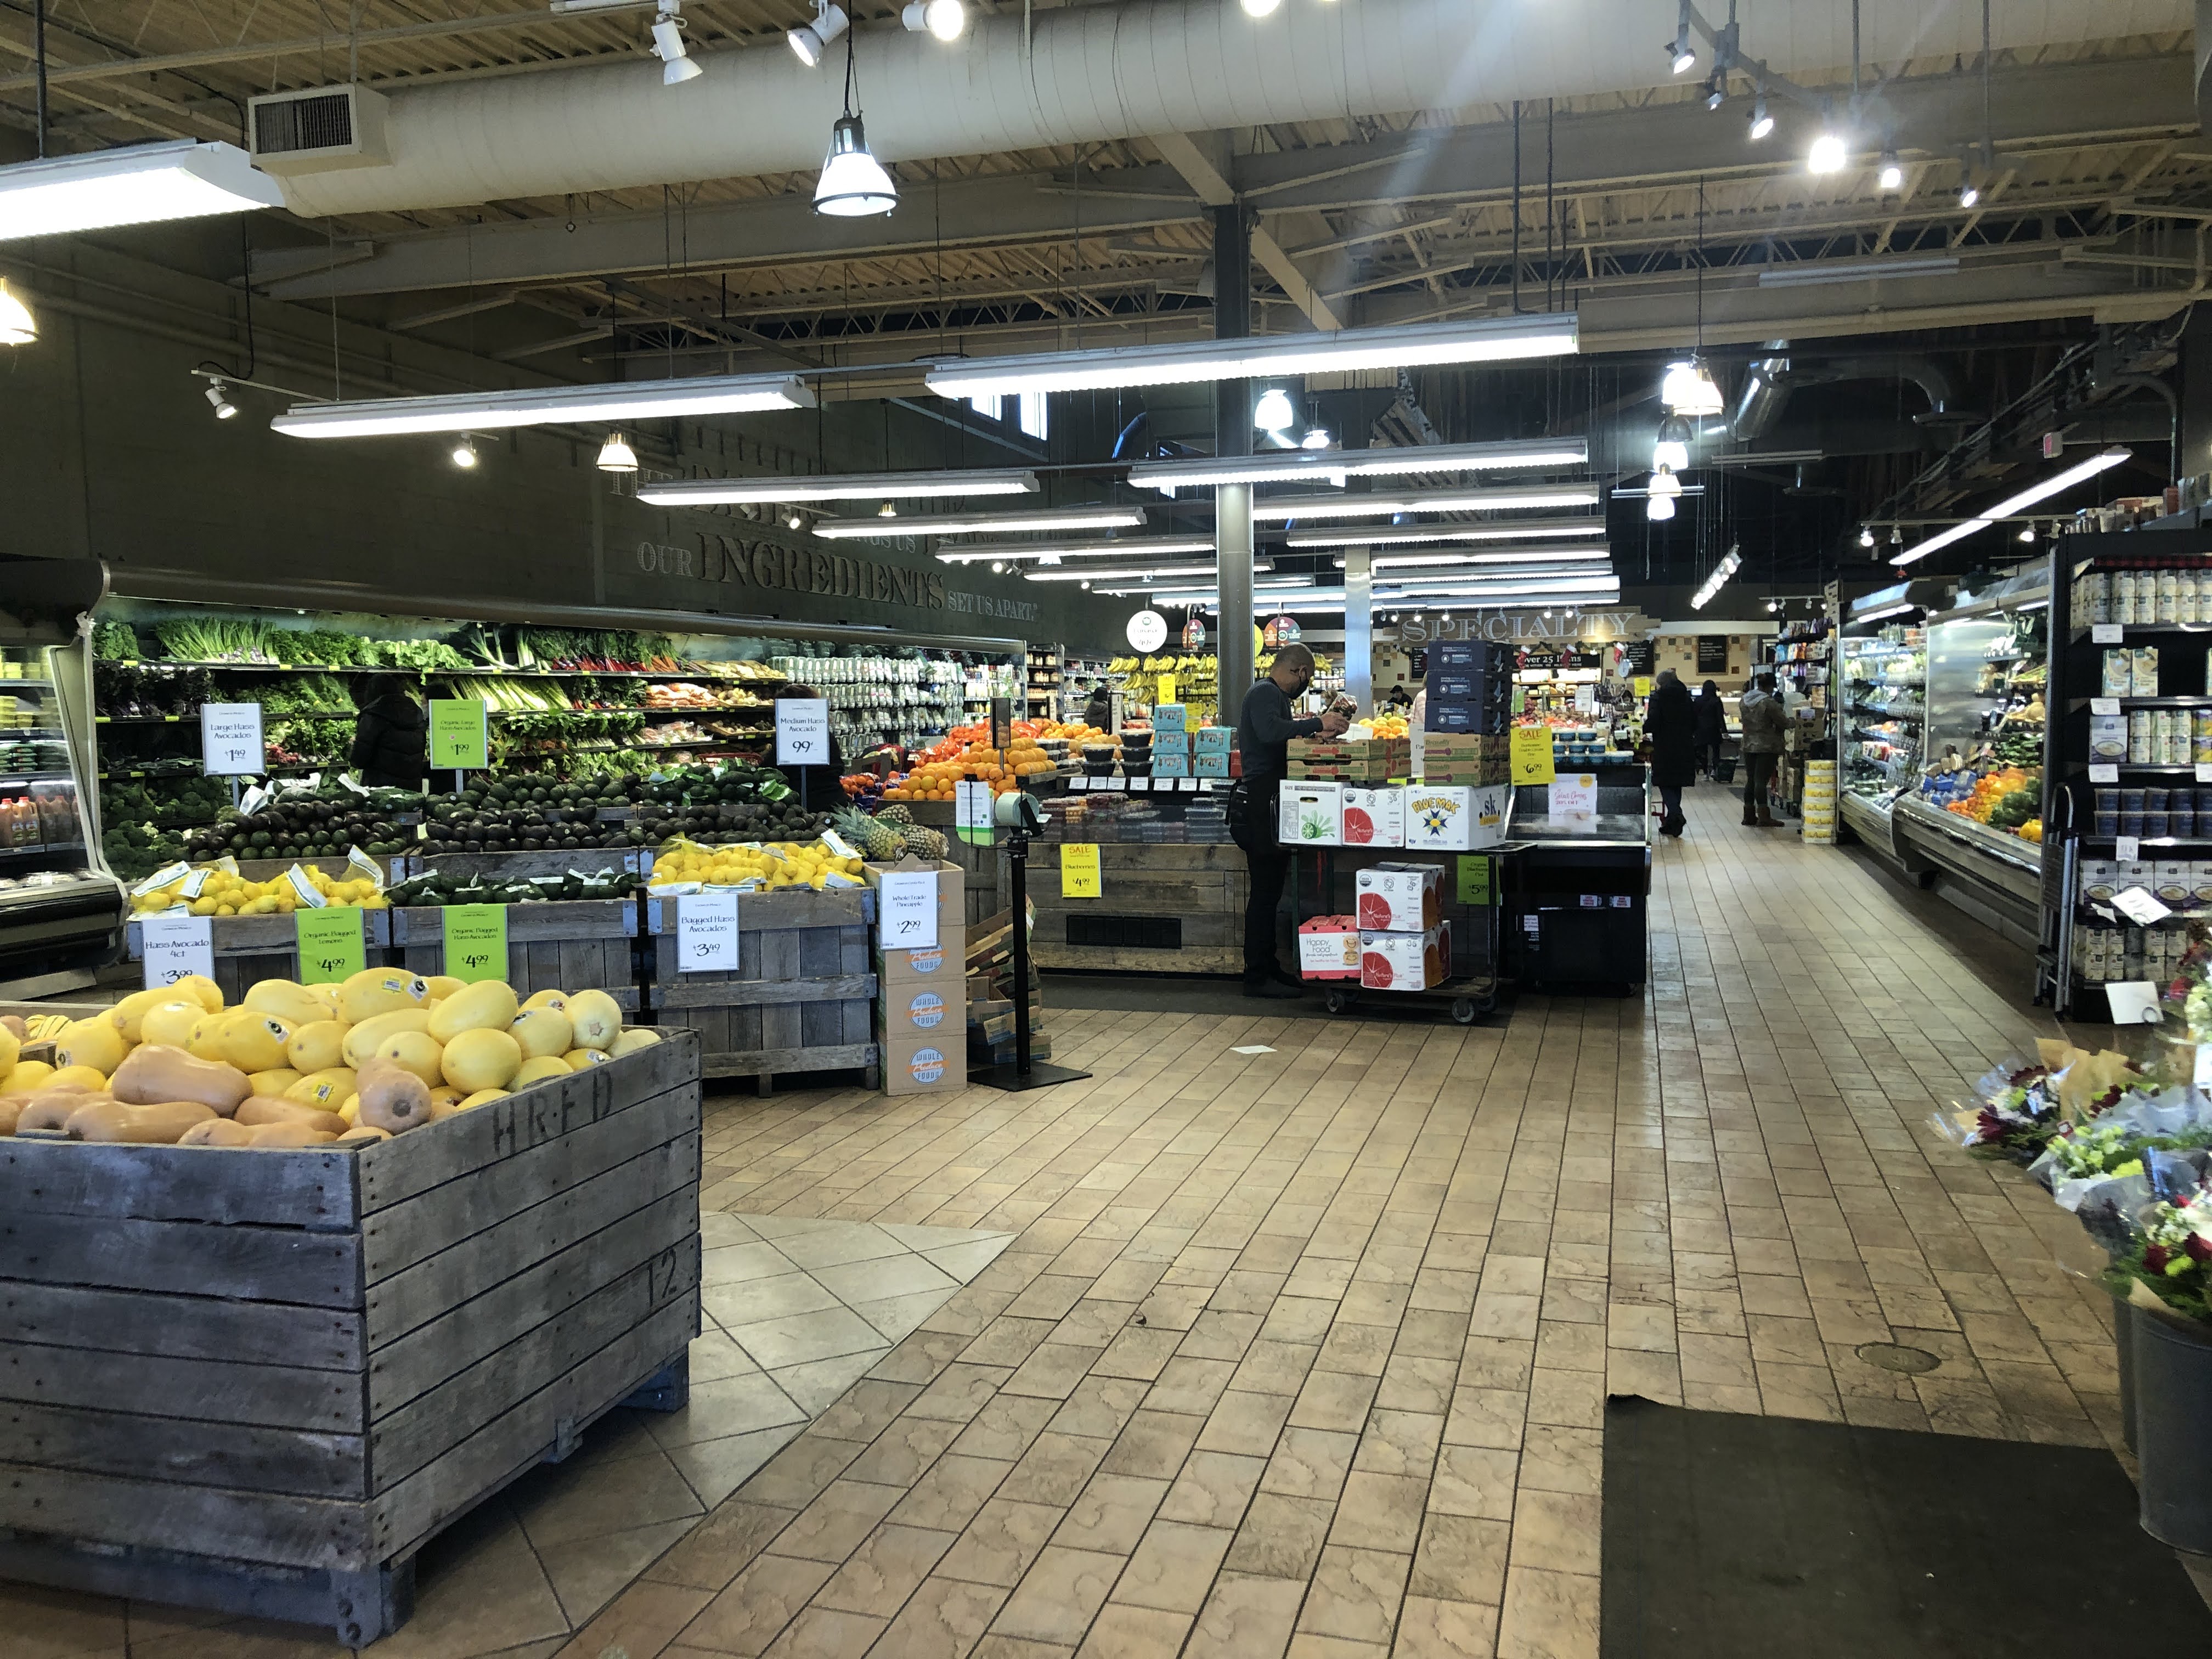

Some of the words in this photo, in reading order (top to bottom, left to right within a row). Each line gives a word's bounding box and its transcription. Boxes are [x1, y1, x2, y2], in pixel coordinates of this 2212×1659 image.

[637, 541, 693, 578] OUR
[697, 532, 945, 610] INGREDIENTS
[948, 591, 973, 613] SET
[974, 595, 994, 617] US
[1402, 612, 1635, 641] SPECIALTY
[1519, 729, 1542, 740] SALE
[1412, 797, 1435, 814] BLUE
[1436, 797, 1460, 814] MAK
[1485, 793, 1496, 816] sk
[1069, 845, 1091, 854] SALE
[681, 916, 712, 925] Bagged
[171, 939, 209, 948] Avocado
[1306, 938, 1329, 946] Happy
[912, 951, 942, 961] Produce
[916, 997, 939, 1006] WHOLE
[912, 1006, 942, 1017] Produce
[916, 1052, 940, 1061] WHOLE
[913, 1060, 943, 1072] Produce
[647, 1248, 676, 1307] 12
